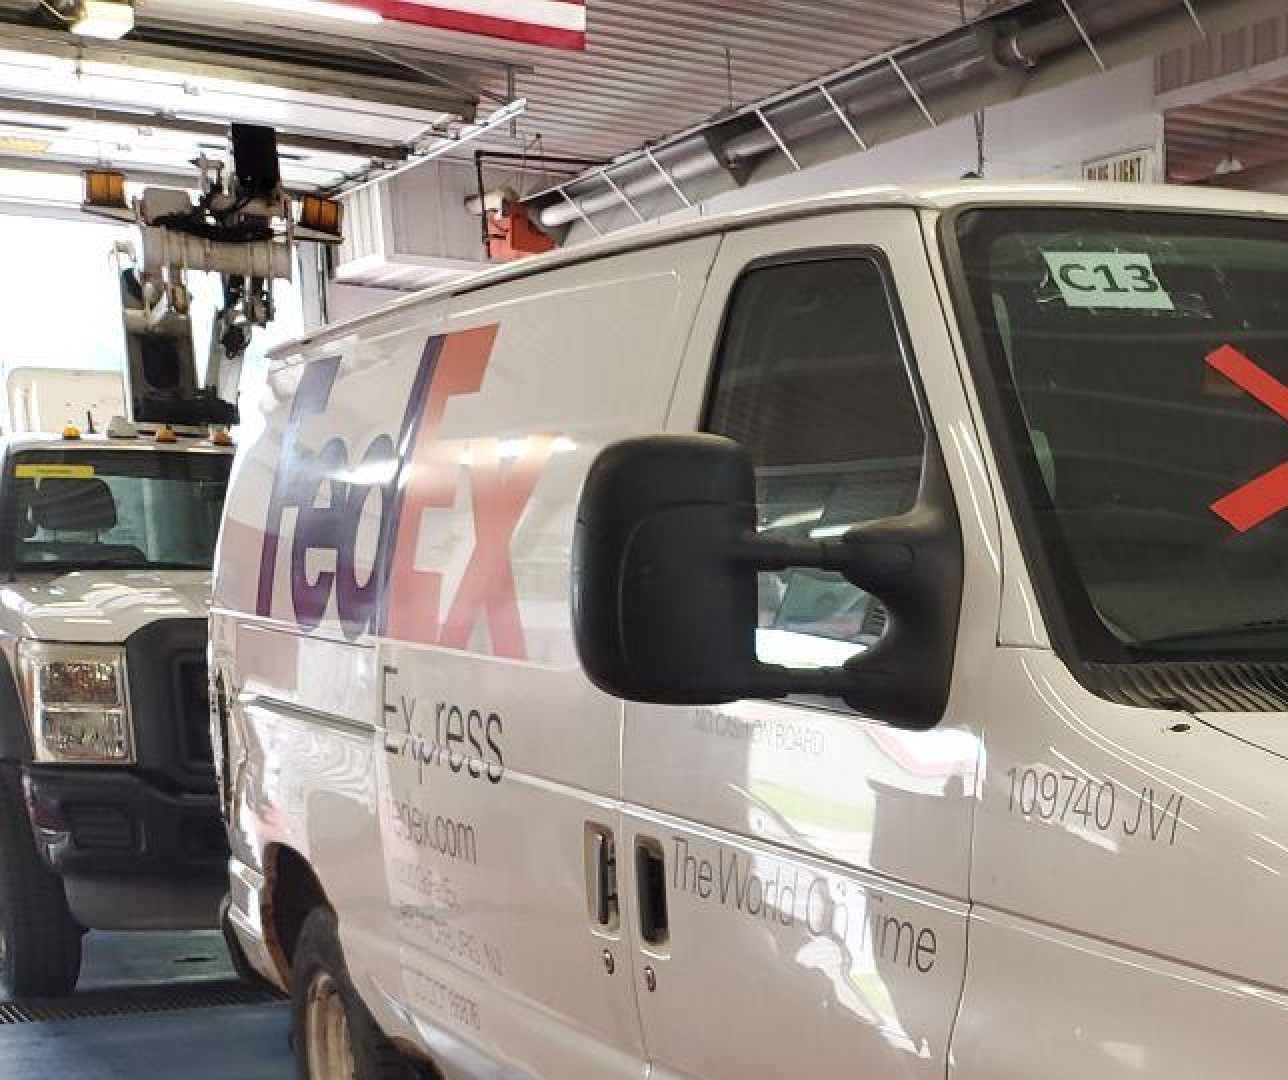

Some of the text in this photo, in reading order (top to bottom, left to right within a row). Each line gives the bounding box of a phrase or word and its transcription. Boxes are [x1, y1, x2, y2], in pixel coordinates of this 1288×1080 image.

[1059, 263, 1159, 293] C13
[255, 321, 567, 661] FedEx
[381, 664, 503, 785] Express
[1007, 767, 1115, 831] 109740
[672, 835, 713, 899] The
[718, 847, 799, 927] World
